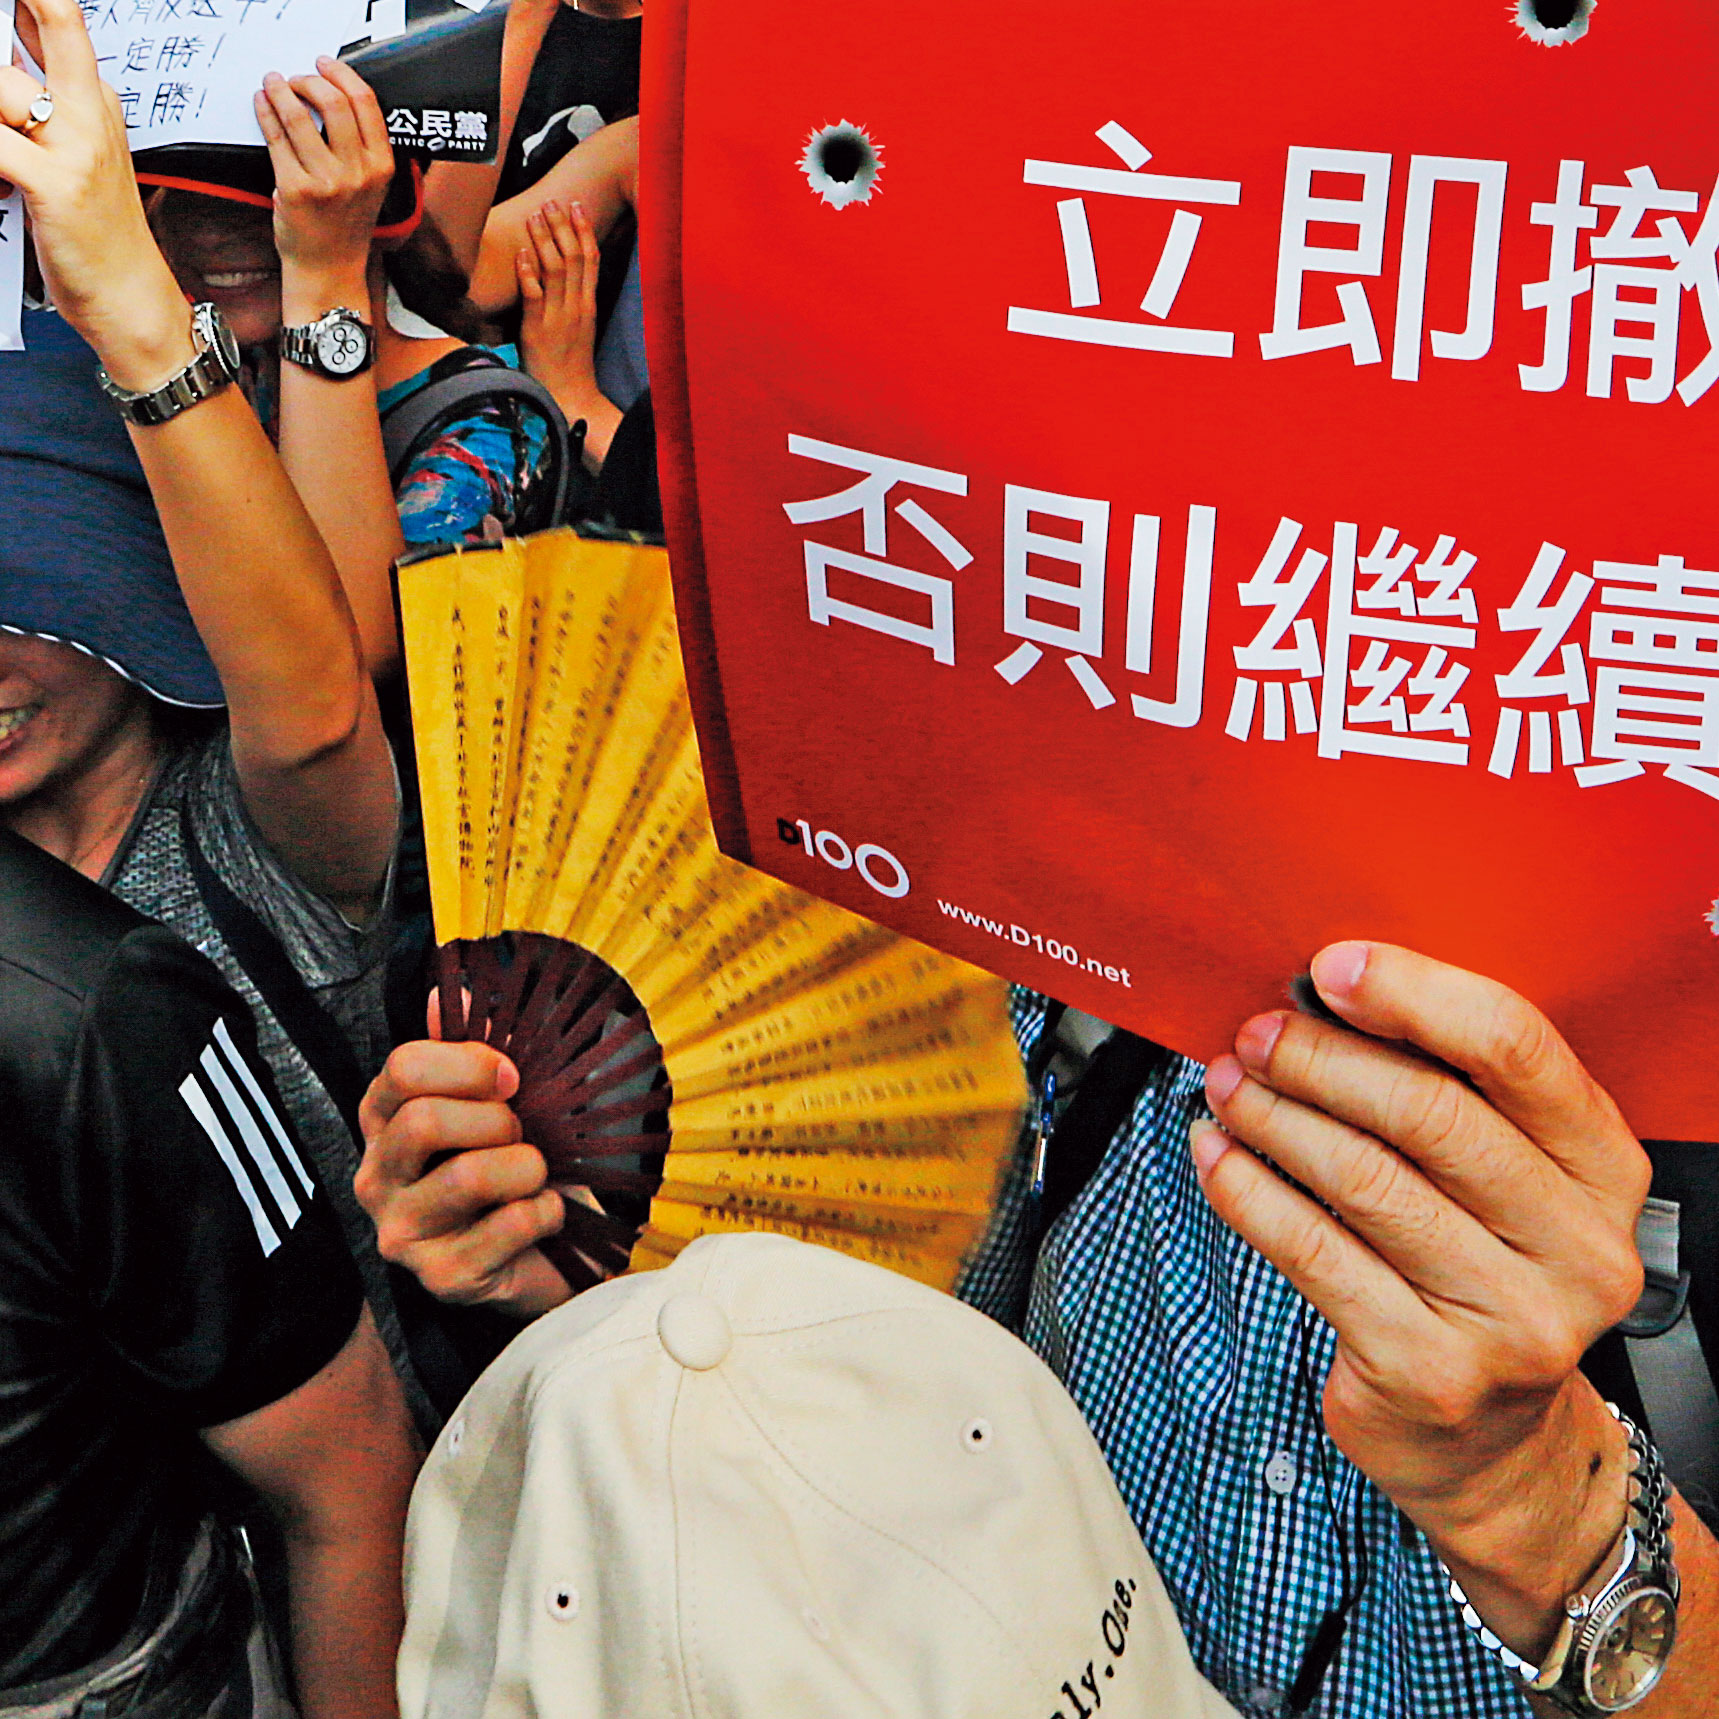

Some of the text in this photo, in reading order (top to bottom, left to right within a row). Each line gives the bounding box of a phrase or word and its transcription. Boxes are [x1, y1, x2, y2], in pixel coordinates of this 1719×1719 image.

[385, 107, 489, 142] 公民黨
[444, 136, 486, 152] PARTY
[776, 816, 912, 900] D100
[935, 897, 1133, 993] www.D100.net
